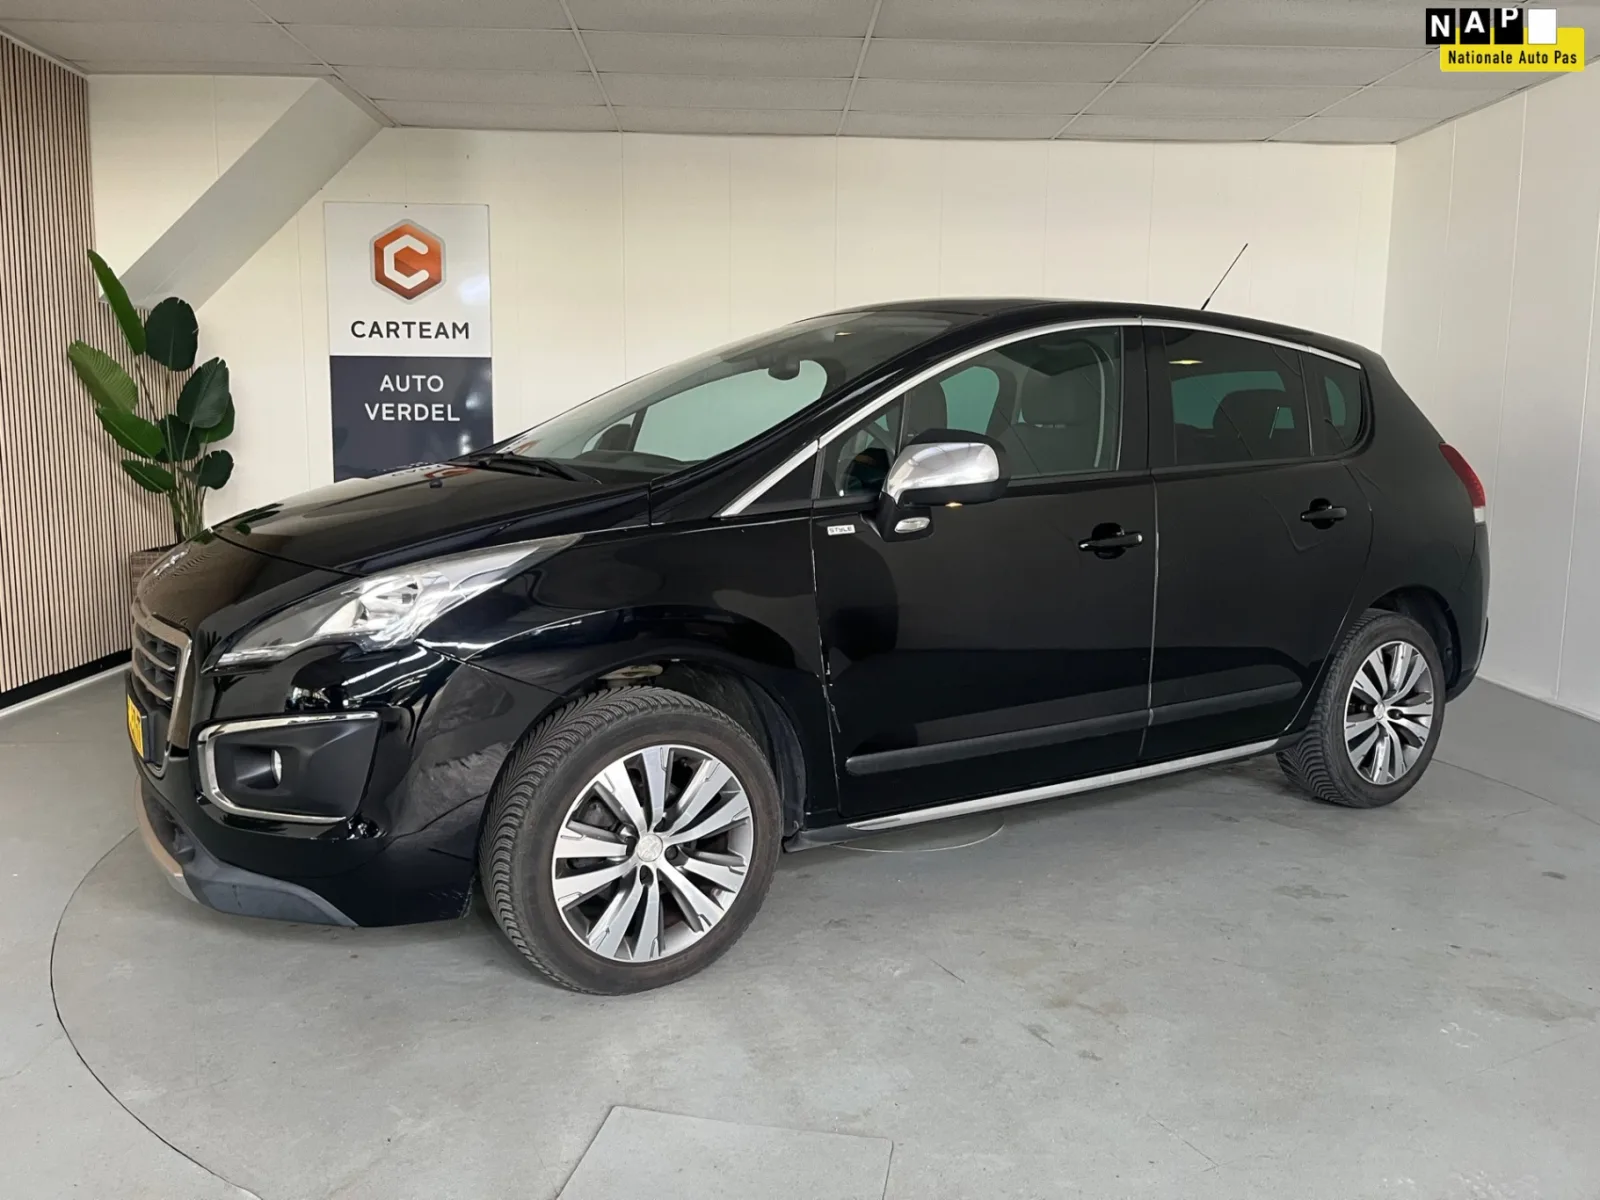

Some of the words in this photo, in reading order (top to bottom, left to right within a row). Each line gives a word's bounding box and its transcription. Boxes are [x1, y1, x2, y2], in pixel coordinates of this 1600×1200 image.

[350, 320, 470, 339] CARTEAM
[379, 374, 444, 392] AUTO
[364, 402, 460, 421] VERDEL
